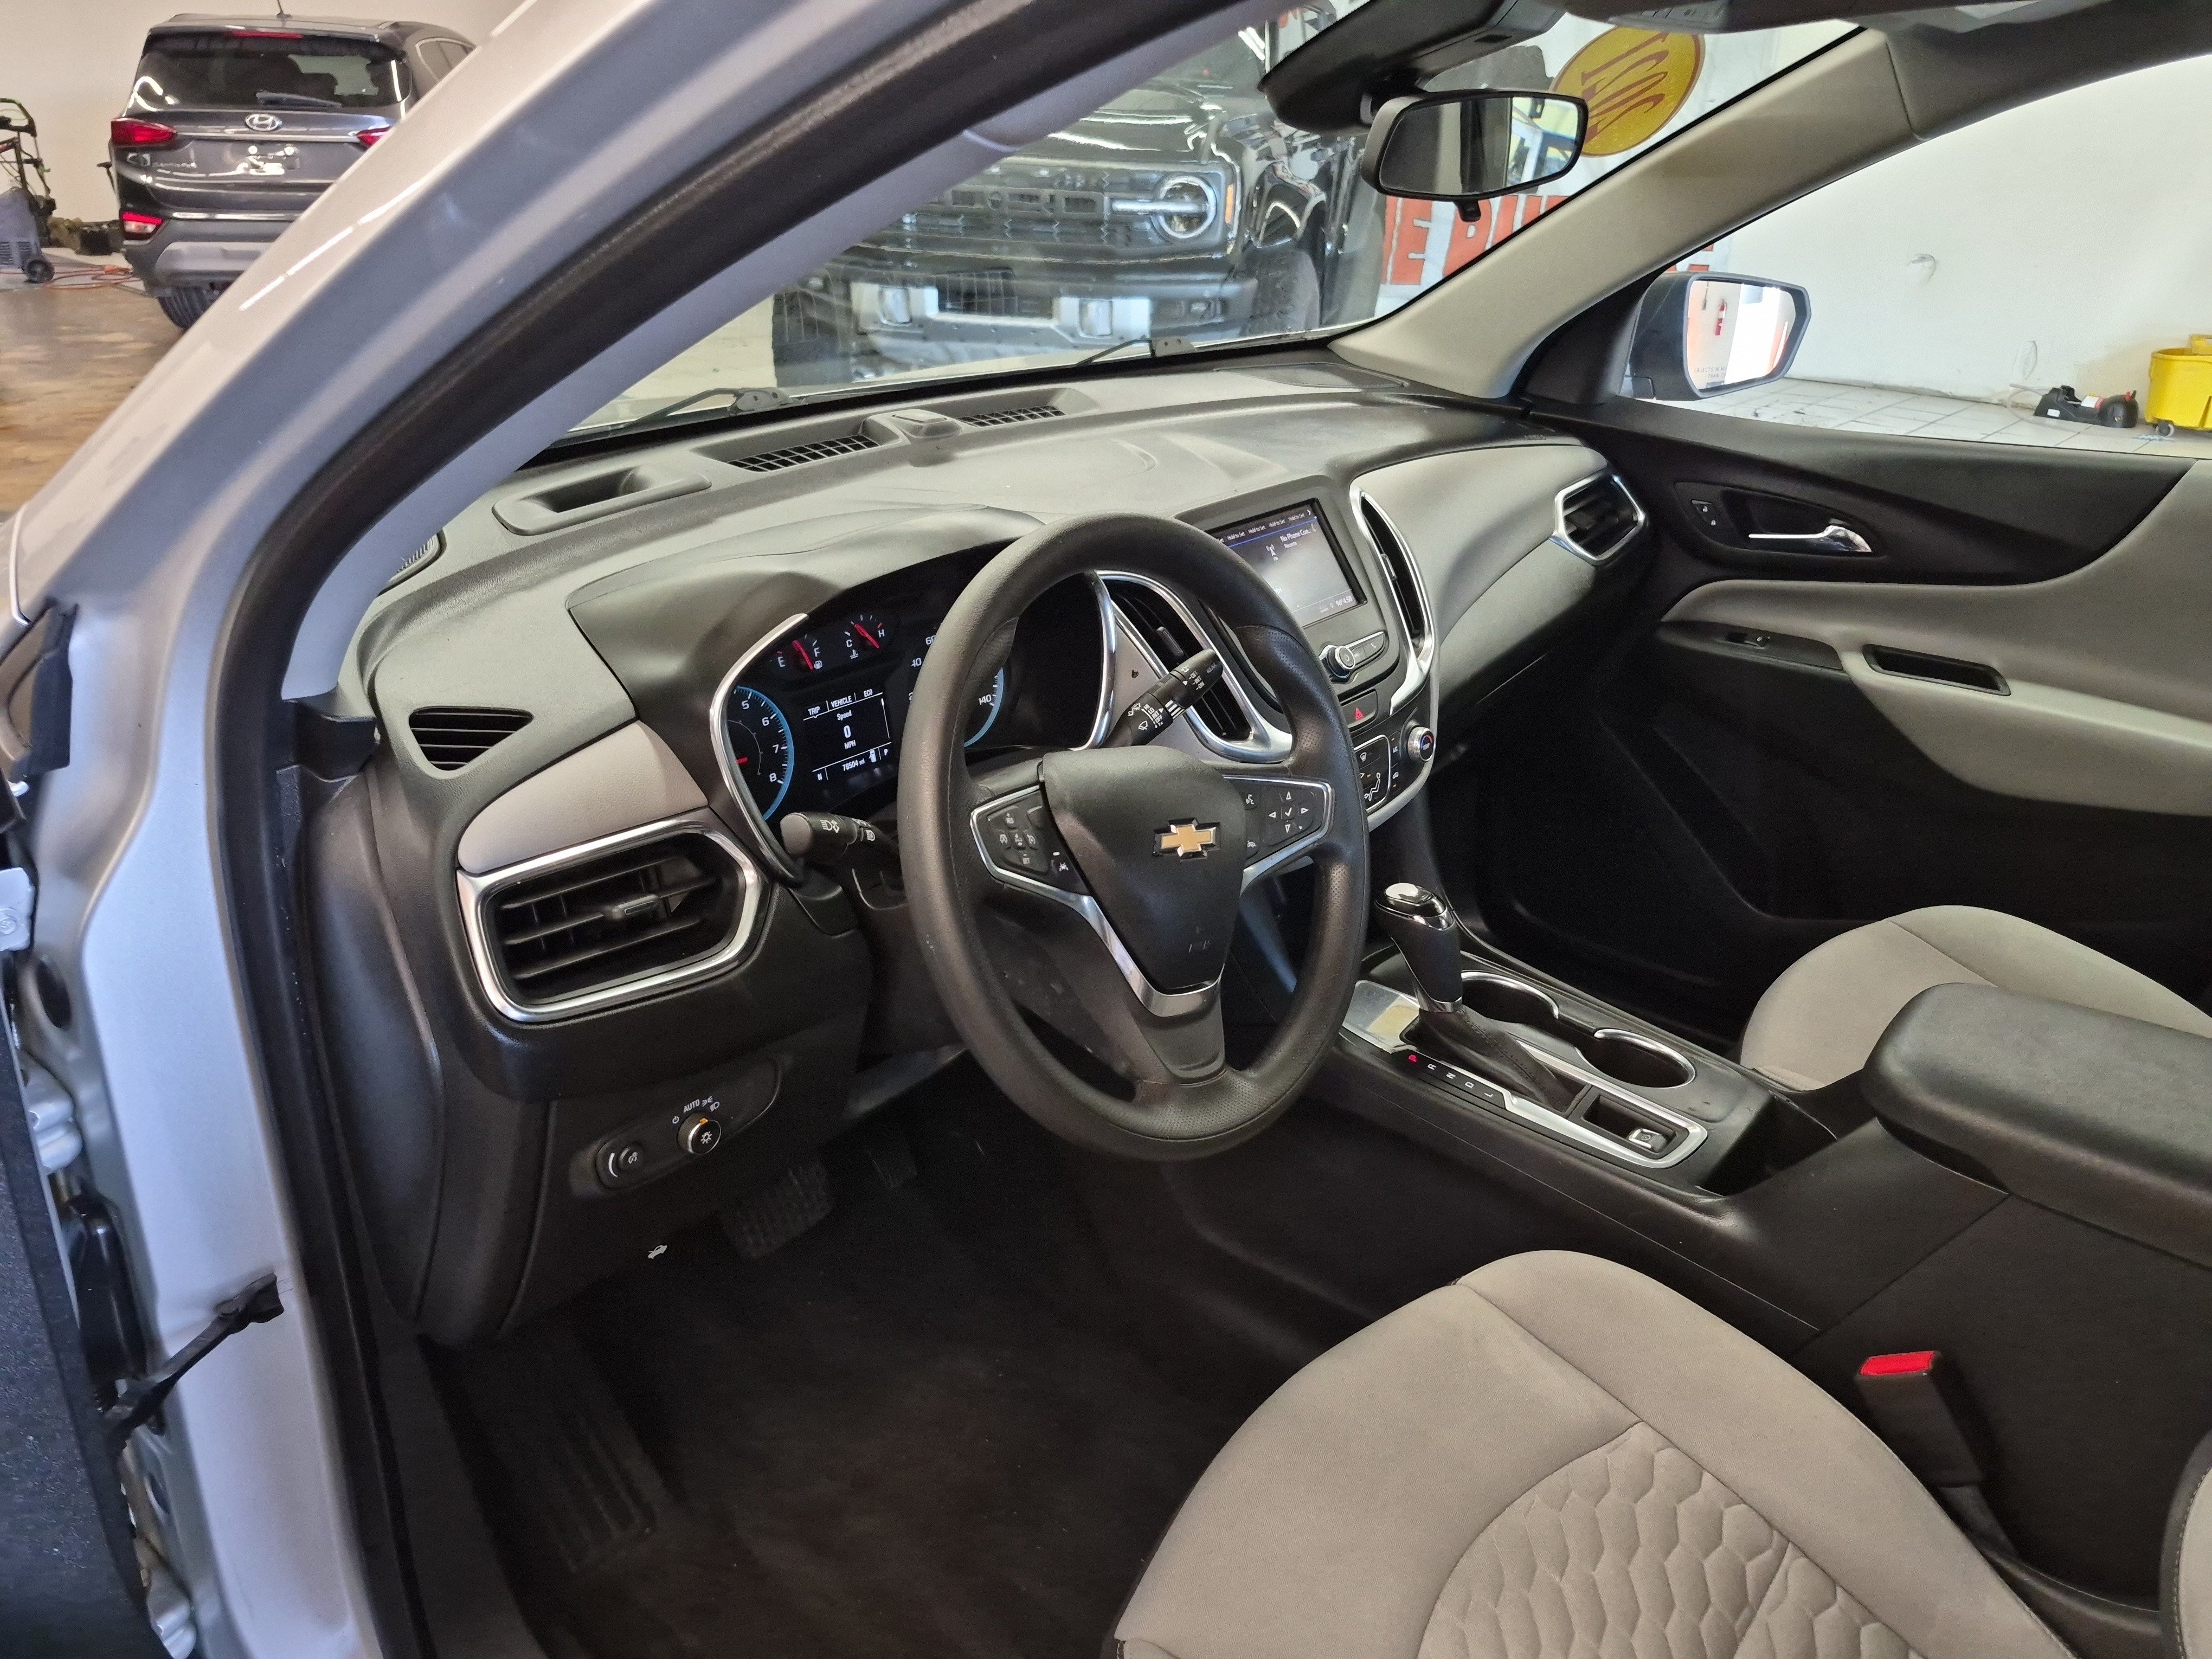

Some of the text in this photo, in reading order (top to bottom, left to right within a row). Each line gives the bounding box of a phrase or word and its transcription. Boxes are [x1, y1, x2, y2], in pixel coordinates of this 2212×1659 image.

[878, 629, 885, 638] H
[846, 639, 852, 647] C
[814, 647, 820, 657] F
[777, 657, 786, 668] E
[808, 689, 873, 716] TRIP VEHICLE ECO
[978, 694, 992, 705] 140
[741, 700, 749, 710] 5
[837, 710, 852, 721] Speed
[762, 717, 770, 726] 6
[844, 725, 851, 738] 0
[772, 744, 779, 754] 7
[844, 740, 856, 749] MPH
[843, 760, 858, 771] 79504
[769, 773, 777, 782] 8
[683, 1099, 700, 1113] AUTO
